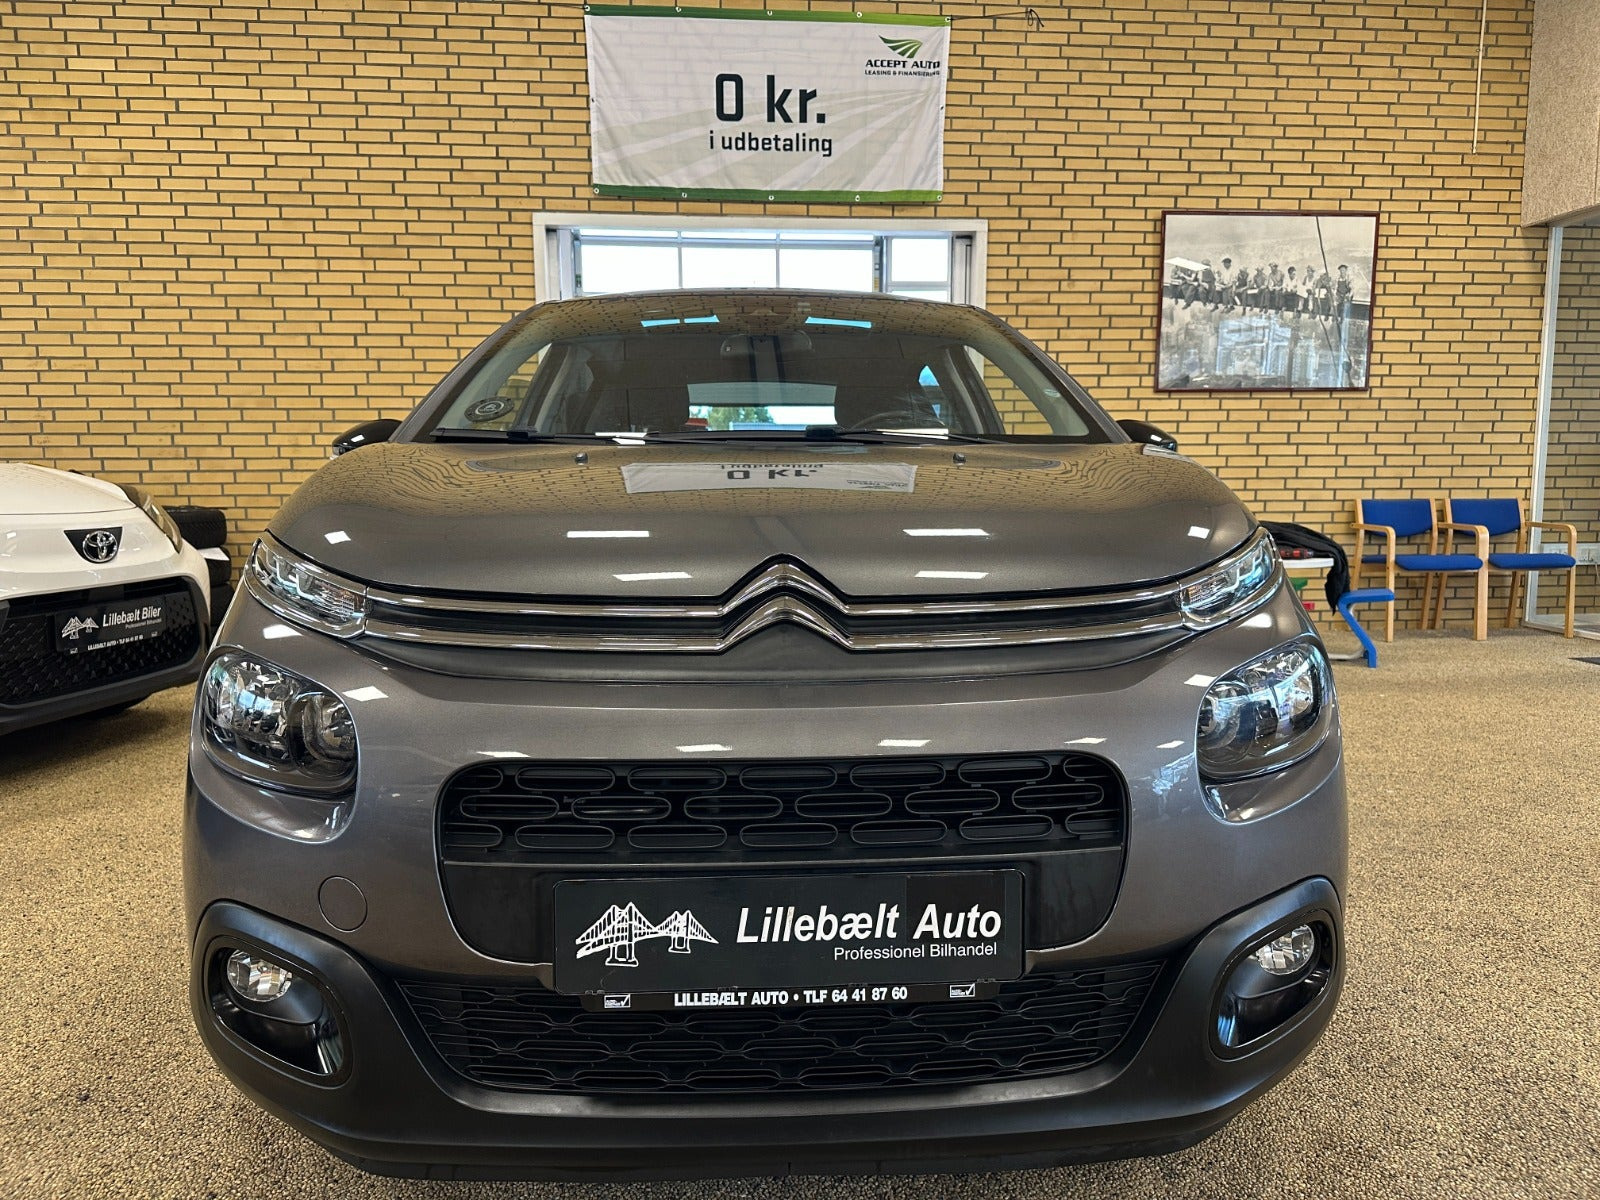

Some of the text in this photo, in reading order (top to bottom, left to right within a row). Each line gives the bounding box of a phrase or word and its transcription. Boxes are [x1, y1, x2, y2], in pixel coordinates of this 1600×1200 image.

[865, 59, 941, 70] ACCEPT AUTO
[715, 73, 826, 124] 0 kr.
[709, 130, 833, 158] i udbetaling
[102, 609, 140, 627] Lillebælt
[141, 605, 162, 619] Biler
[736, 903, 1002, 943] Lillebælt Auto
[834, 941, 998, 961] Professionel Bilhandel
[674, 986, 908, 1007] LILLEBÆLT AUTO TLF 64 41 87 60
